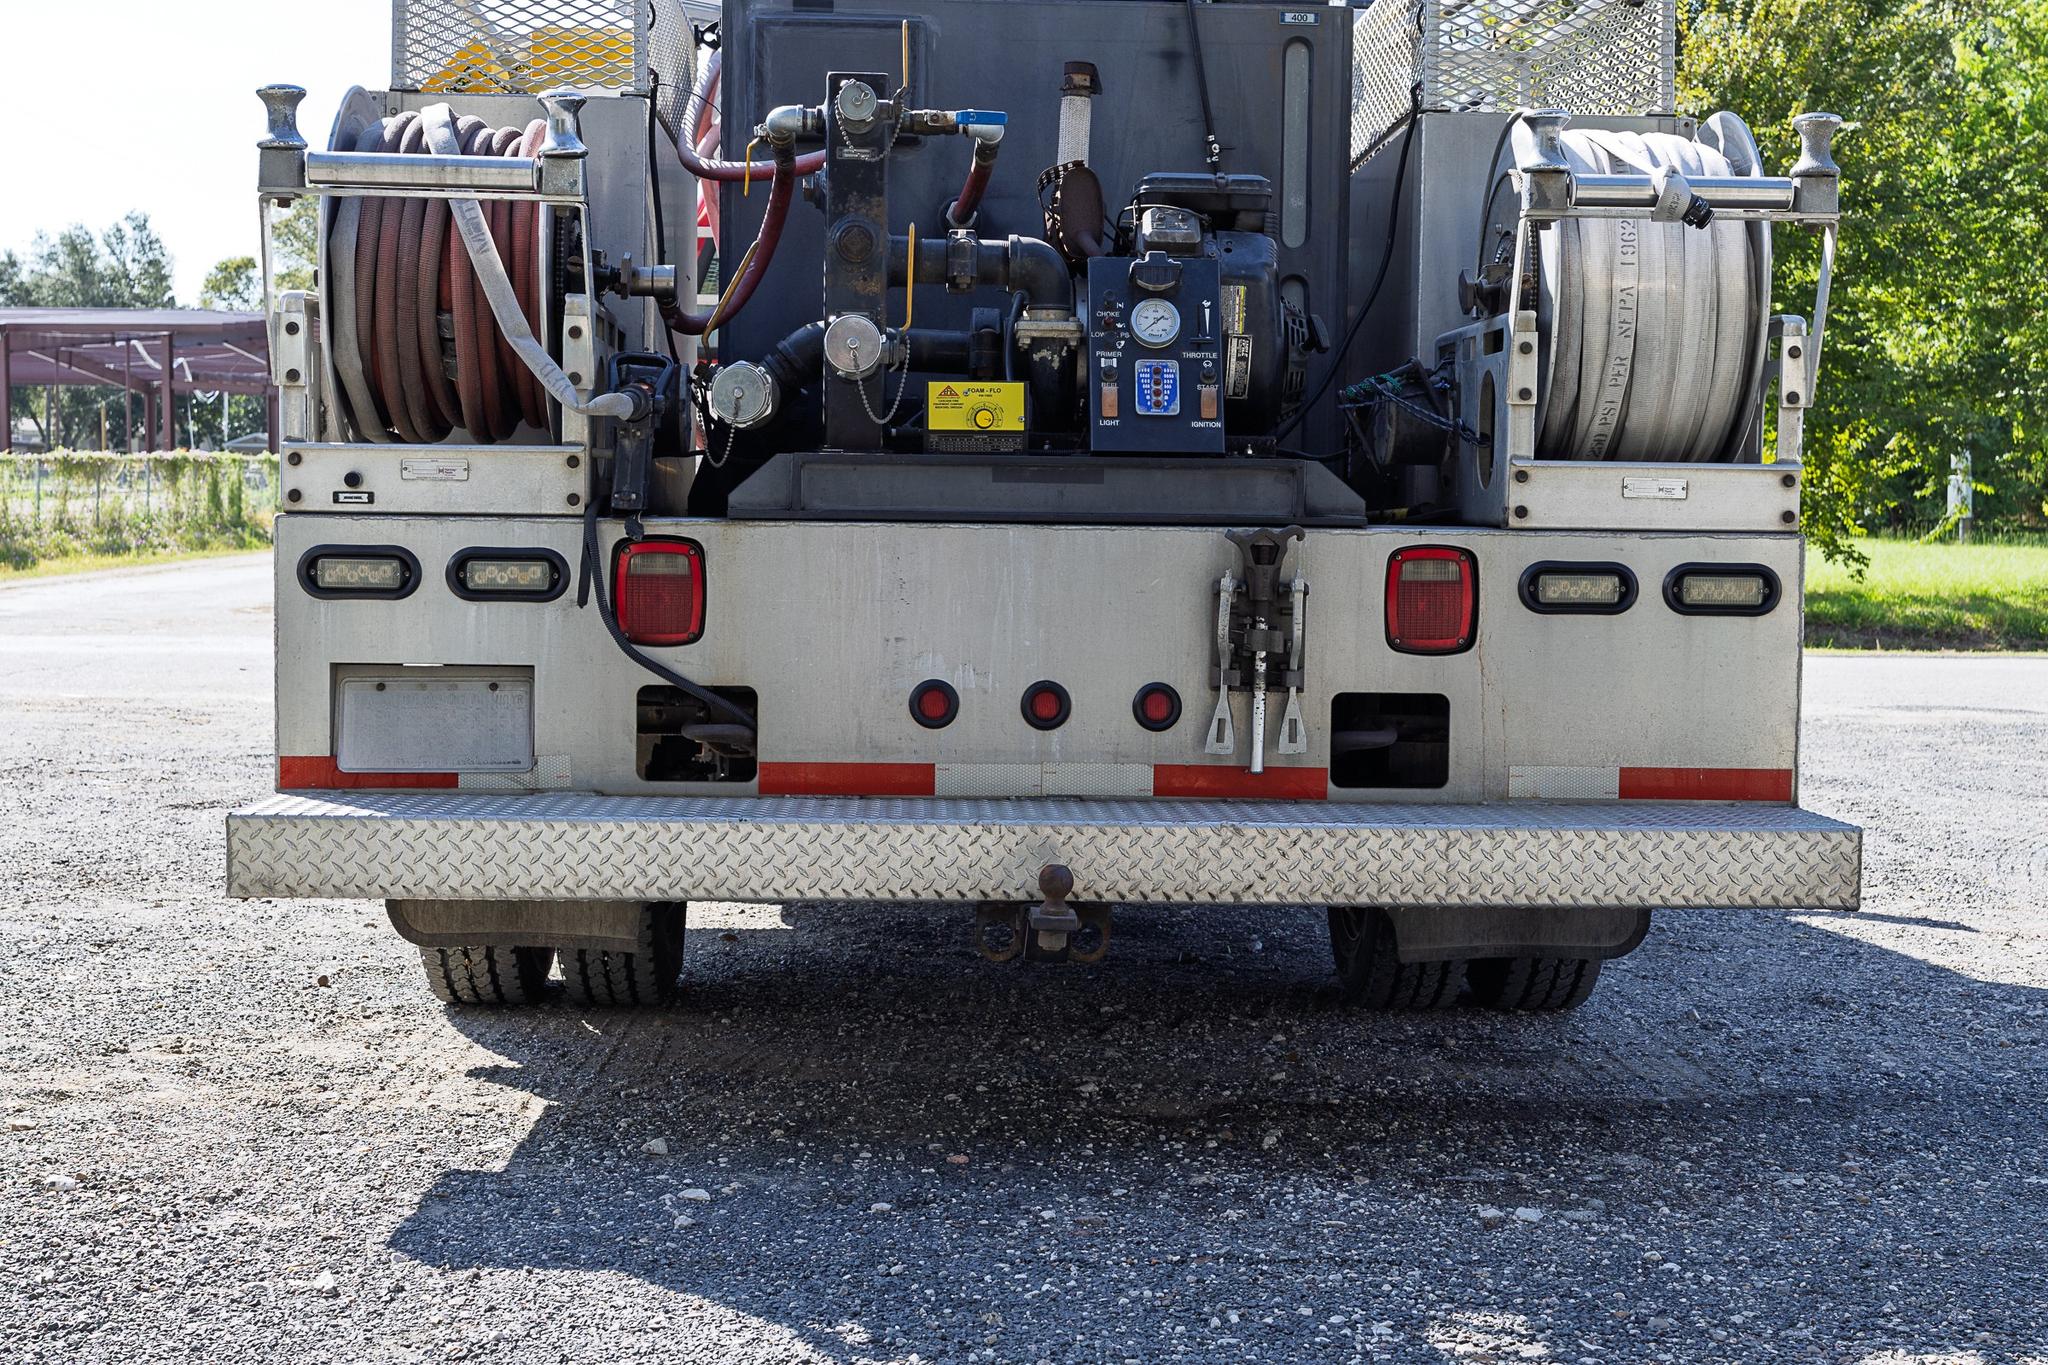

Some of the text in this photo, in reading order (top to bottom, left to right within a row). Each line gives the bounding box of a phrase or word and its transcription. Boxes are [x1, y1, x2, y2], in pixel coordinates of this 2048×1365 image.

[1292, 14, 1308, 22] 400
[1586, 219, 1636, 458] 250 PSI PER NFPA 1962
[1095, 350, 1122, 358] PRIMER
